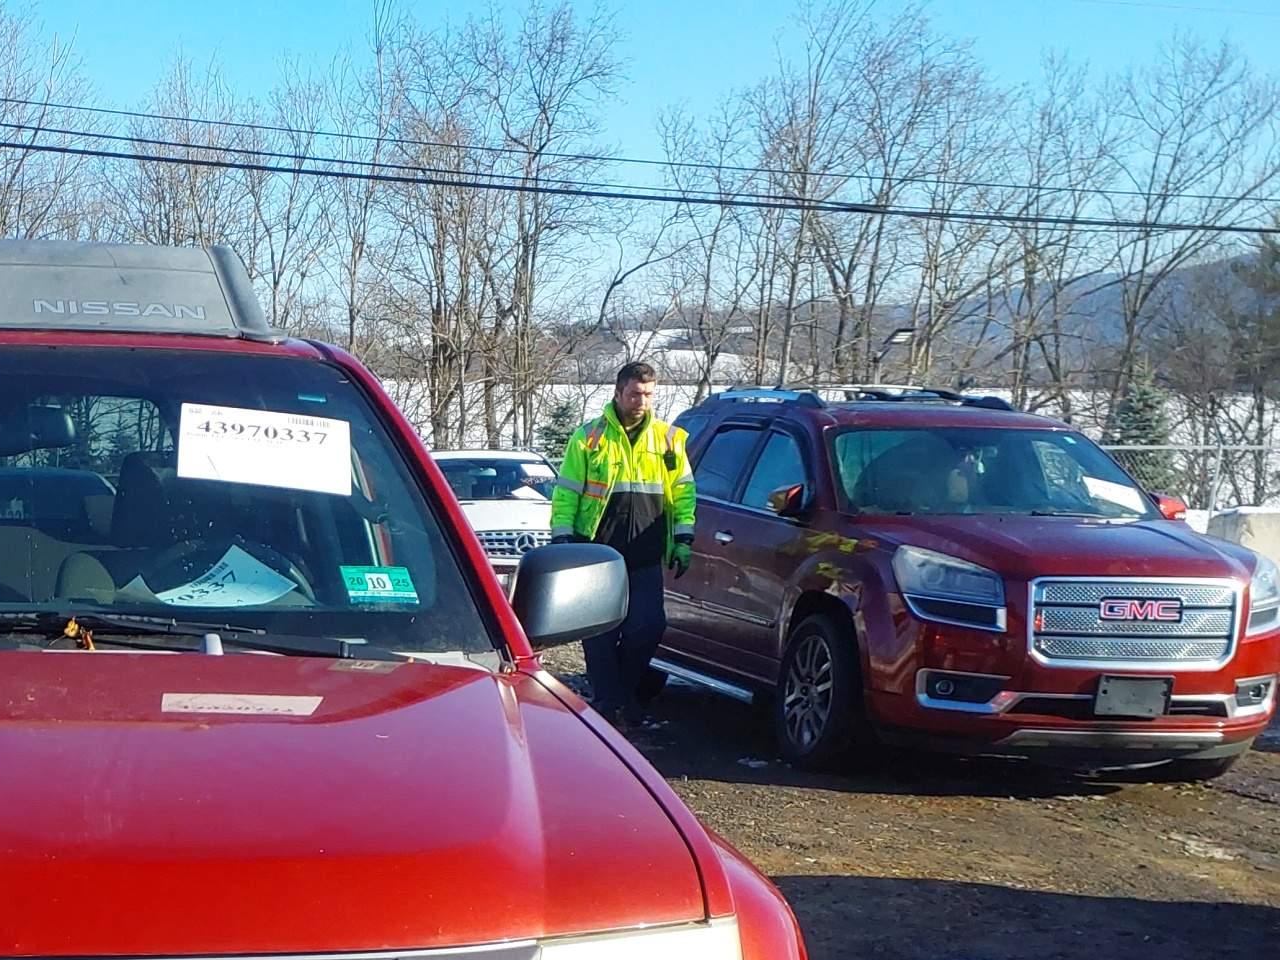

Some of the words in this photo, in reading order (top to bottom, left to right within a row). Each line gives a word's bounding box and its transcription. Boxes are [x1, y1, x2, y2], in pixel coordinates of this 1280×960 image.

[33, 299, 207, 320] NISSAN
[197, 420, 328, 445] 43970337
[348, 576, 364, 586] 20
[368, 576, 387, 589] 10
[393, 578, 409, 588] 25
[1100, 599, 1182, 620] GMC
